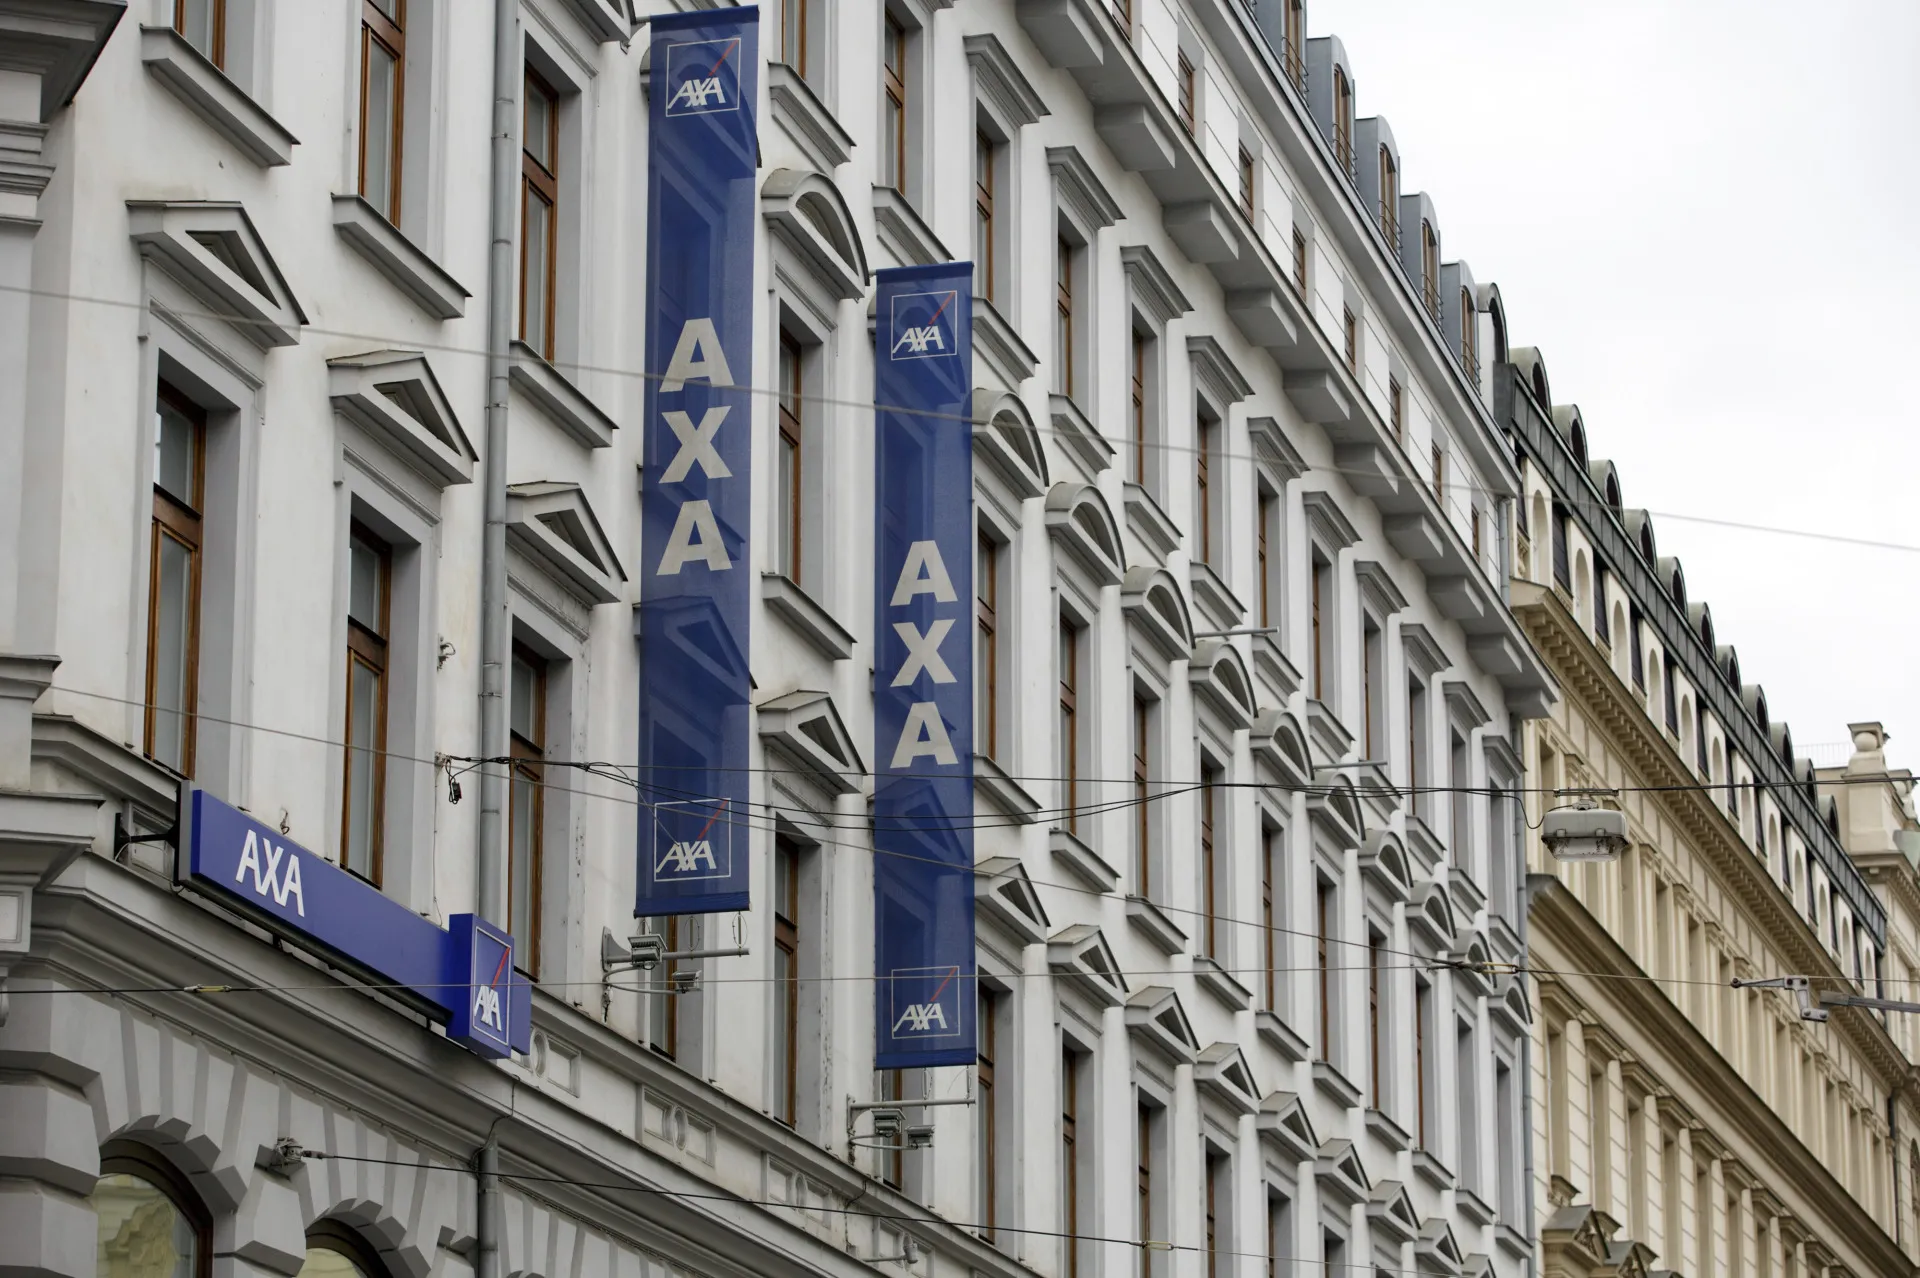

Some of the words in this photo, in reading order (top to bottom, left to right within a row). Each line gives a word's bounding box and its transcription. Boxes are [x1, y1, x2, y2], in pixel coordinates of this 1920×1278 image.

[668, 77, 726, 109] AXA
[892, 325, 945, 353] AXA
[656, 317, 735, 575] AXA
[890, 540, 958, 768] AXA
[235, 829, 305, 917] AXA
[656, 840, 717, 873] AXA
[474, 984, 502, 1031] AXA
[893, 1003, 948, 1032] AXA
